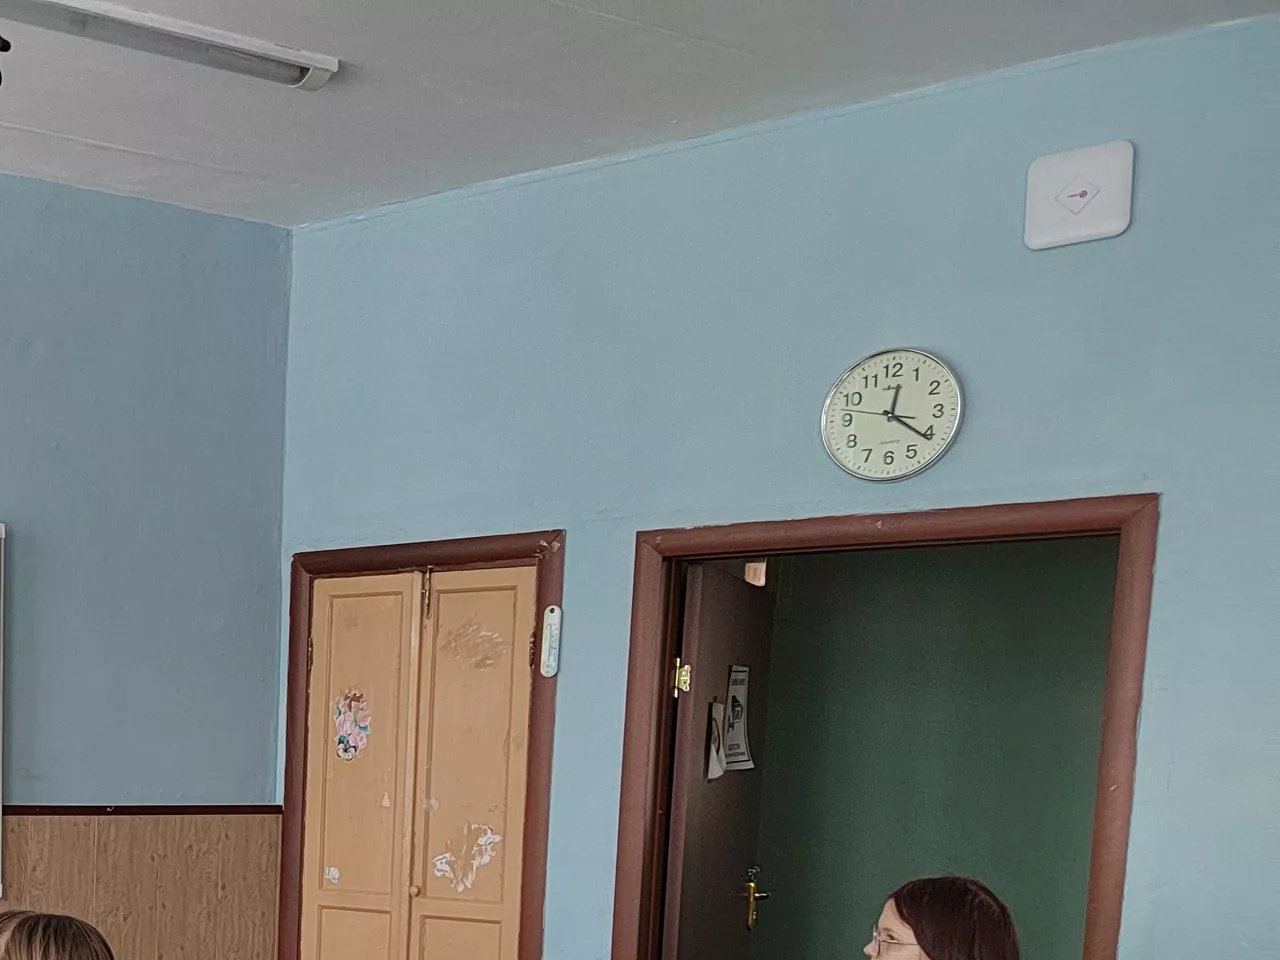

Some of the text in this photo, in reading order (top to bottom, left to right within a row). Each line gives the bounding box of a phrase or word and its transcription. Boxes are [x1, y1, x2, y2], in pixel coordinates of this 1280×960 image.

[883, 363, 904, 379] 12
[912, 366, 920, 382] 1
[862, 374, 879, 389] 11
[928, 380, 941, 396] 2
[843, 391, 863, 408] 10
[932, 403, 945, 419] 3
[841, 413, 853, 428] 9
[922, 424, 936, 440] 4
[846, 434, 858, 449] 8
[861, 449, 873, 464] 7
[883, 450, 895, 466] 6
[905, 444, 918, 459] 5
